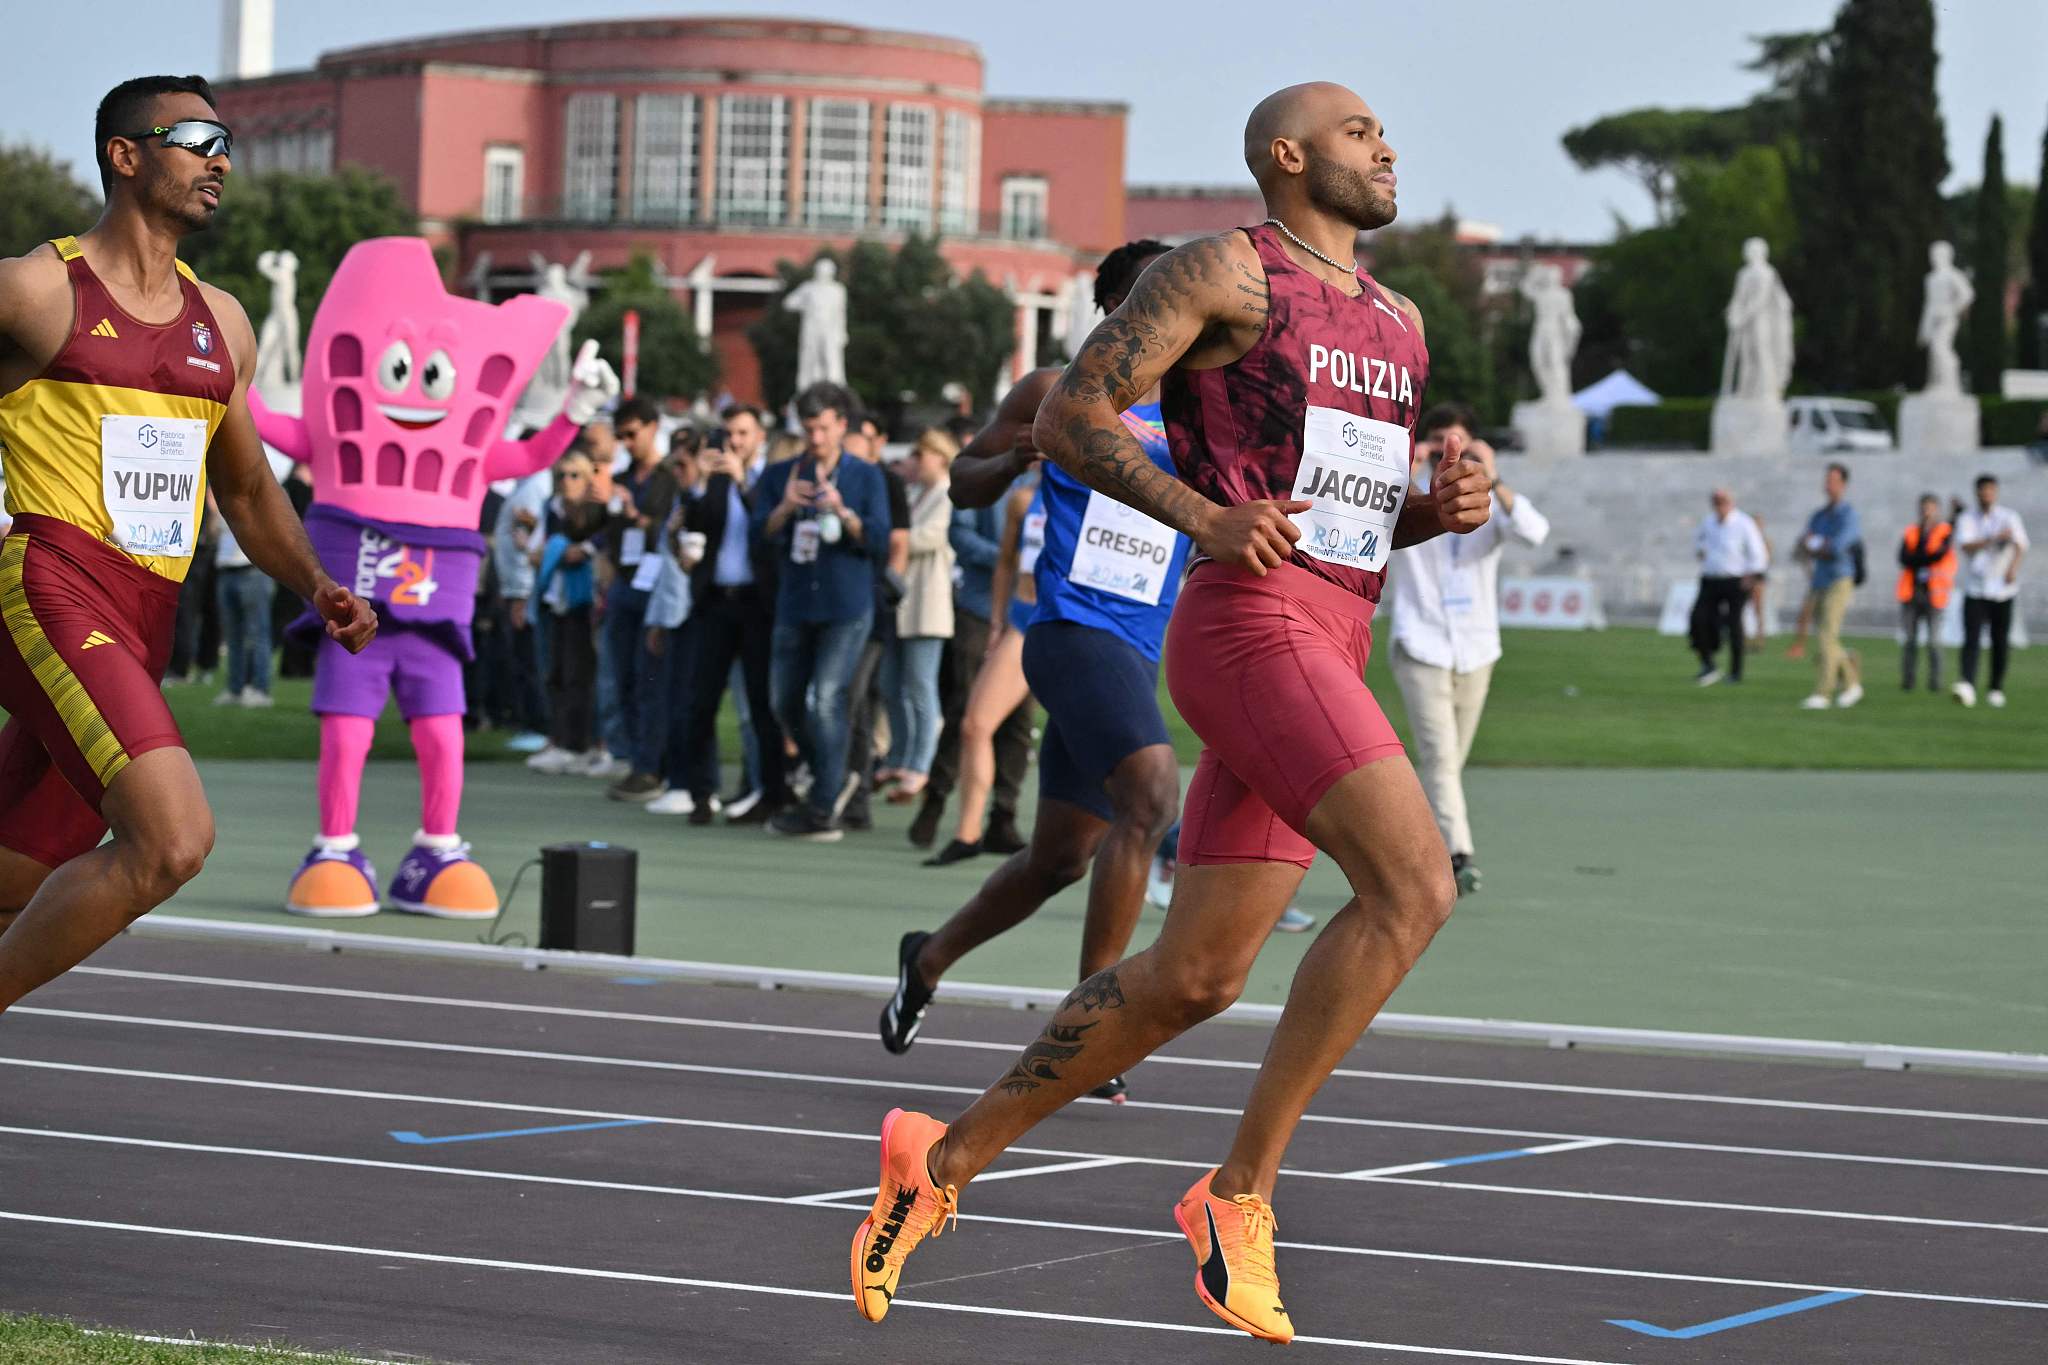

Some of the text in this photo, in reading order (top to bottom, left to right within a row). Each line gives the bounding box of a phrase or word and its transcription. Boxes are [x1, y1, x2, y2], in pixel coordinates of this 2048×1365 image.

[1310, 343, 1413, 406] POLIZIA
[138, 424, 158, 448] FIS
[1343, 421, 1359, 447] FIS
[1360, 431, 1386, 445] Fabbrica
[1360, 441, 1383, 452] Italiana
[1360, 448, 1385, 462] Sintetici
[113, 470, 194, 502] YUPUN
[1302, 466, 1402, 514] JACOBS
[169, 519, 183, 548] 24
[1086, 526, 1166, 565] CRESPO
[1359, 529, 1379, 562] 24
[866, 1184, 919, 1273] NITRO
